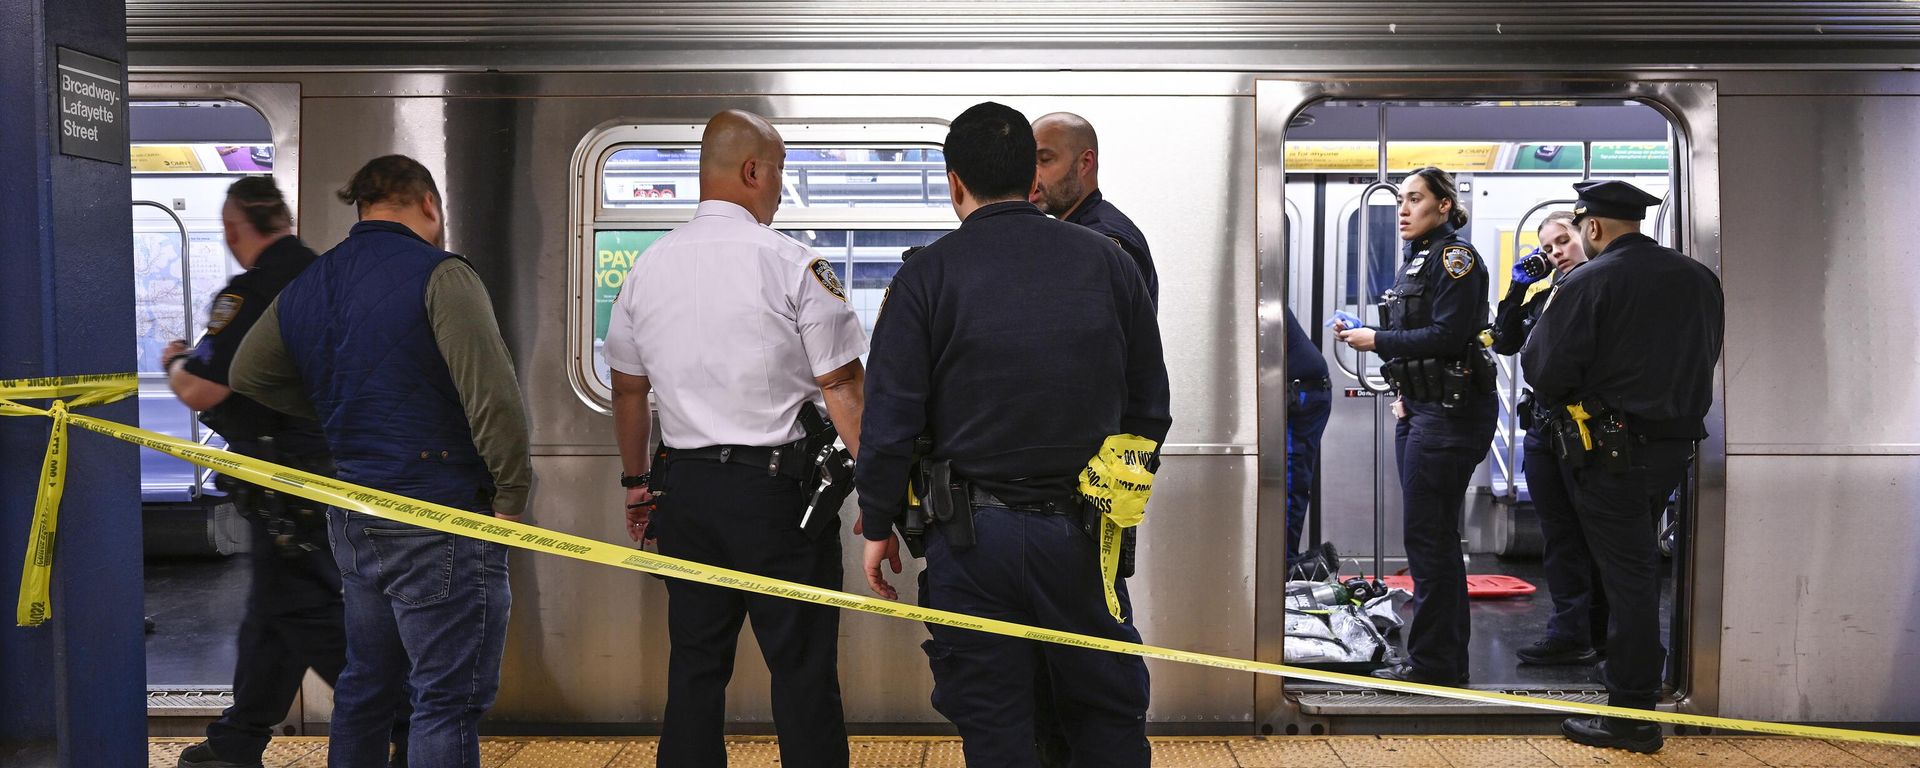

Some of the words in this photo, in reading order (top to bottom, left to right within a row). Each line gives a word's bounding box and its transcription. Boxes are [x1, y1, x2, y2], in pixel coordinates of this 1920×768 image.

[62, 74, 120, 105] Broadway-
[63, 96, 114, 123] Lafayette
[64, 119, 98, 141] Street
[599, 250, 639, 269] PAY
[1124, 450, 1137, 465] DO
